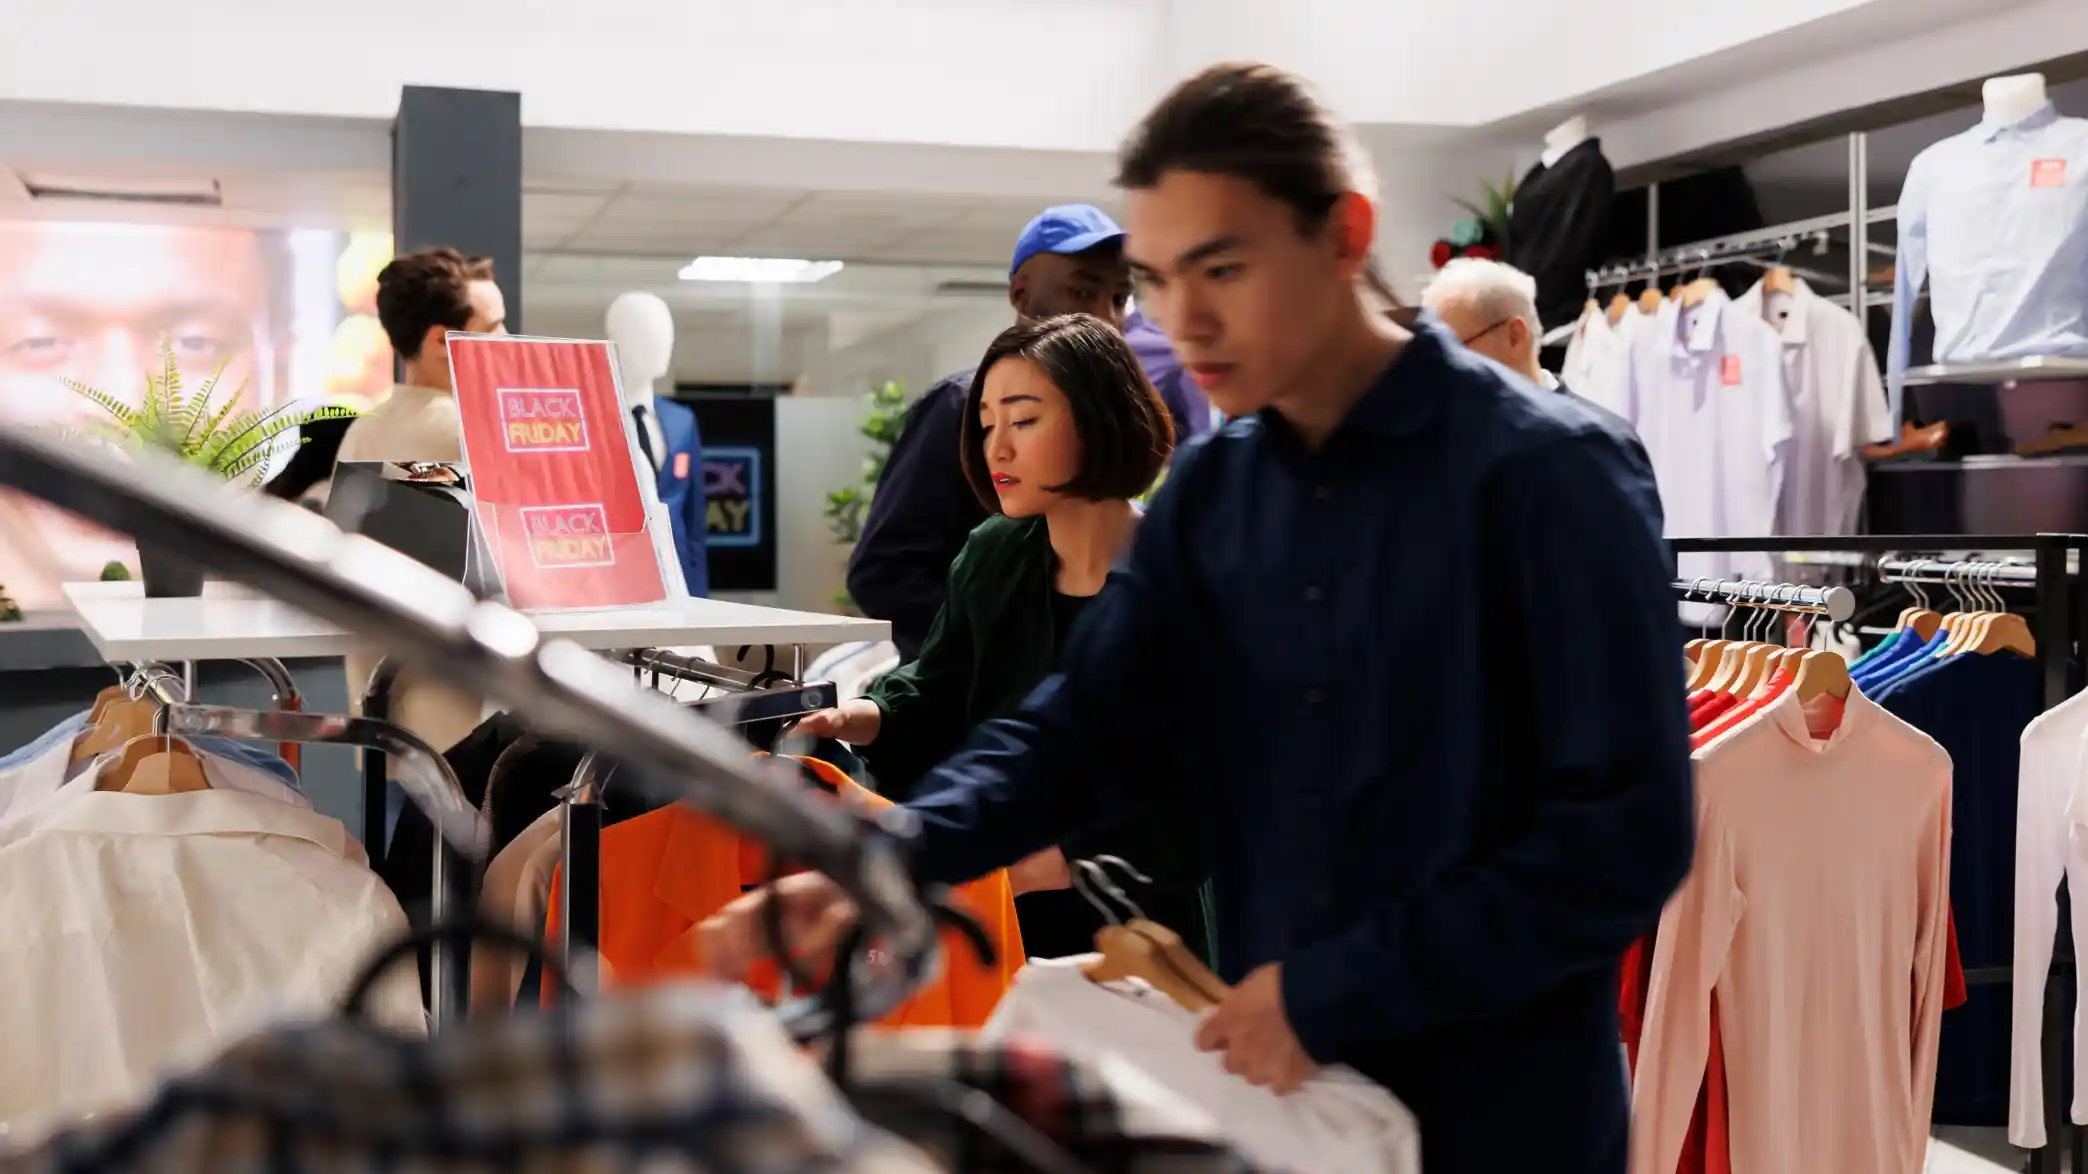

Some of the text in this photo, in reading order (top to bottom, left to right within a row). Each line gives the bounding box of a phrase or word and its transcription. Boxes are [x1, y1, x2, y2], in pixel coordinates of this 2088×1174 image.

[508, 397, 577, 418] BLACK
[508, 422, 580, 445] FRIDAY
[531, 512, 600, 535] BLACK
[535, 537, 606, 560] FRIDAY
